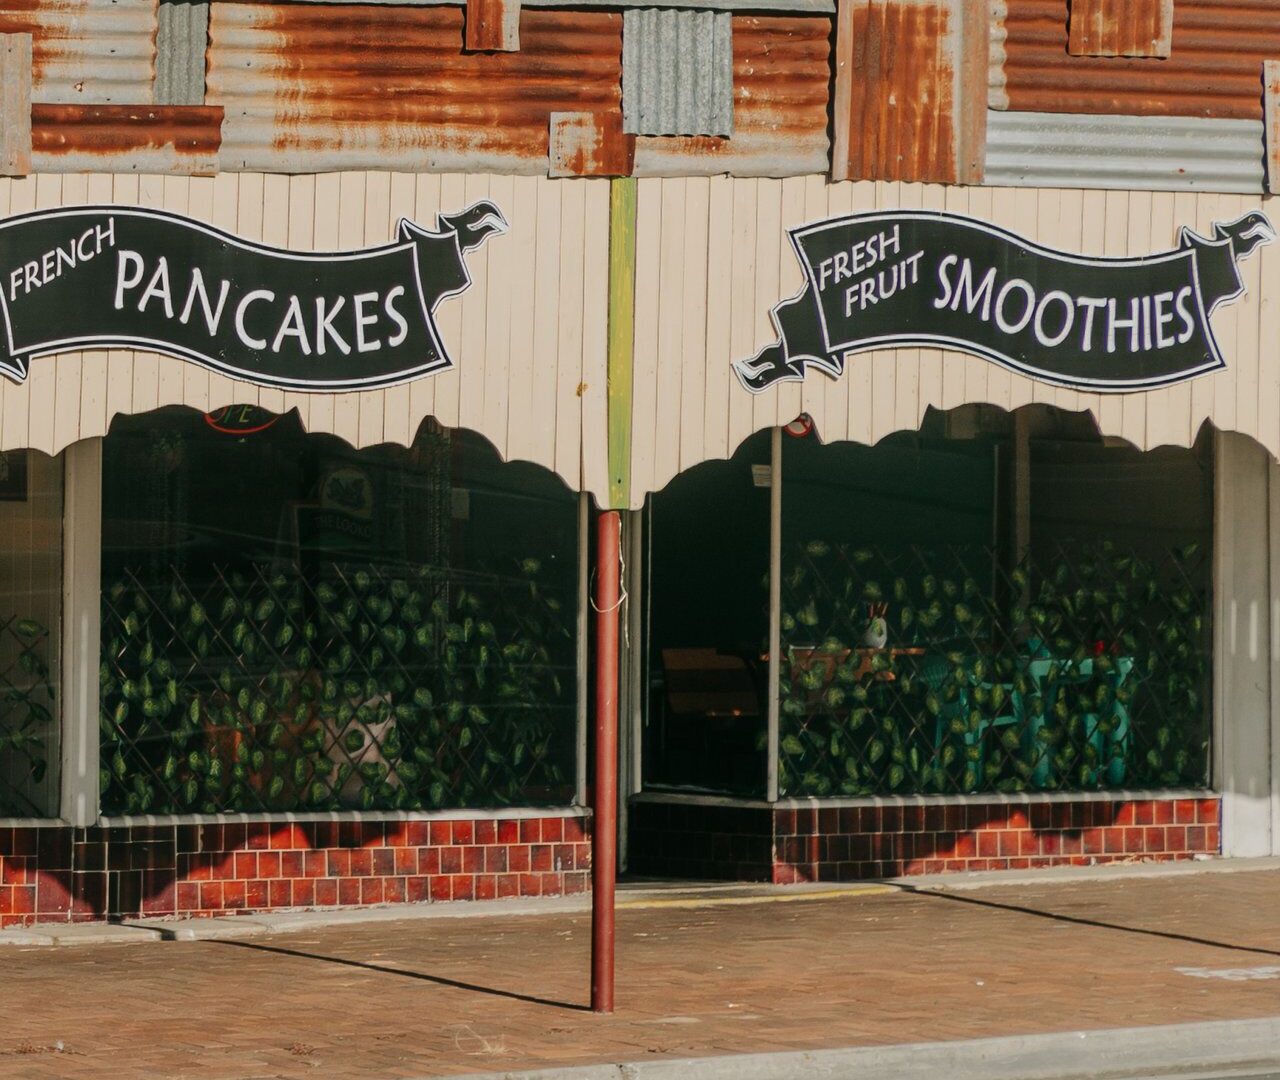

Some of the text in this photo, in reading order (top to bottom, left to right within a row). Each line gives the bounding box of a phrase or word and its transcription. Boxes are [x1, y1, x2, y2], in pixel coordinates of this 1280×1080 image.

[9, 217, 409, 356] FRENCH PANCAKES
[818, 224, 901, 292] FRESH
[844, 250, 925, 318] FRUIT
[934, 254, 1196, 354] SMOOTHIES
